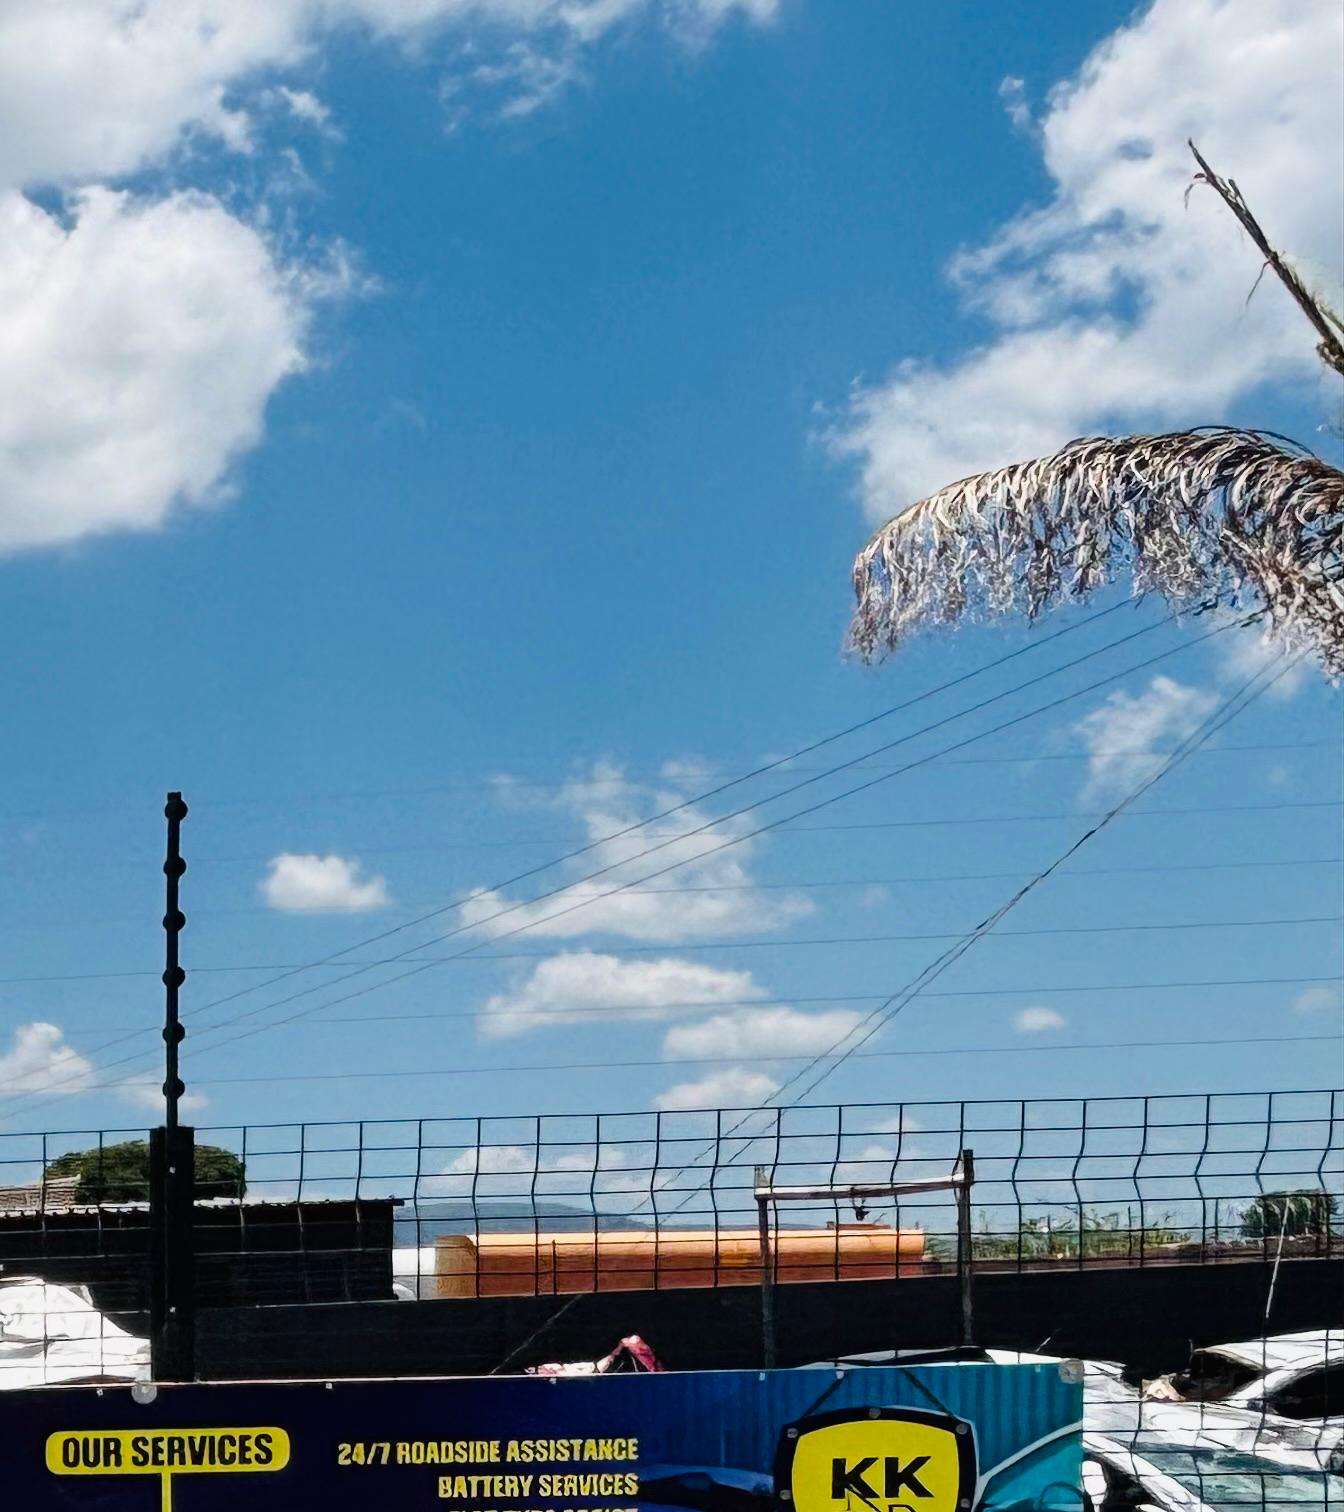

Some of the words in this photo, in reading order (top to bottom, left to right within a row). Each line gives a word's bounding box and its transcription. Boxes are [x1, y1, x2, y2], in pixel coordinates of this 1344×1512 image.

[62, 1437, 122, 1468] OUR
[131, 1434, 273, 1466] SERVICES
[337, 1442, 391, 1465] 24/7
[396, 1440, 501, 1464] ROADSIDE
[506, 1438, 639, 1462] ASSISTANCE
[438, 1475, 533, 1498] BATTERY
[538, 1473, 639, 1497] SERVICES
[831, 1455, 934, 1499] KK
